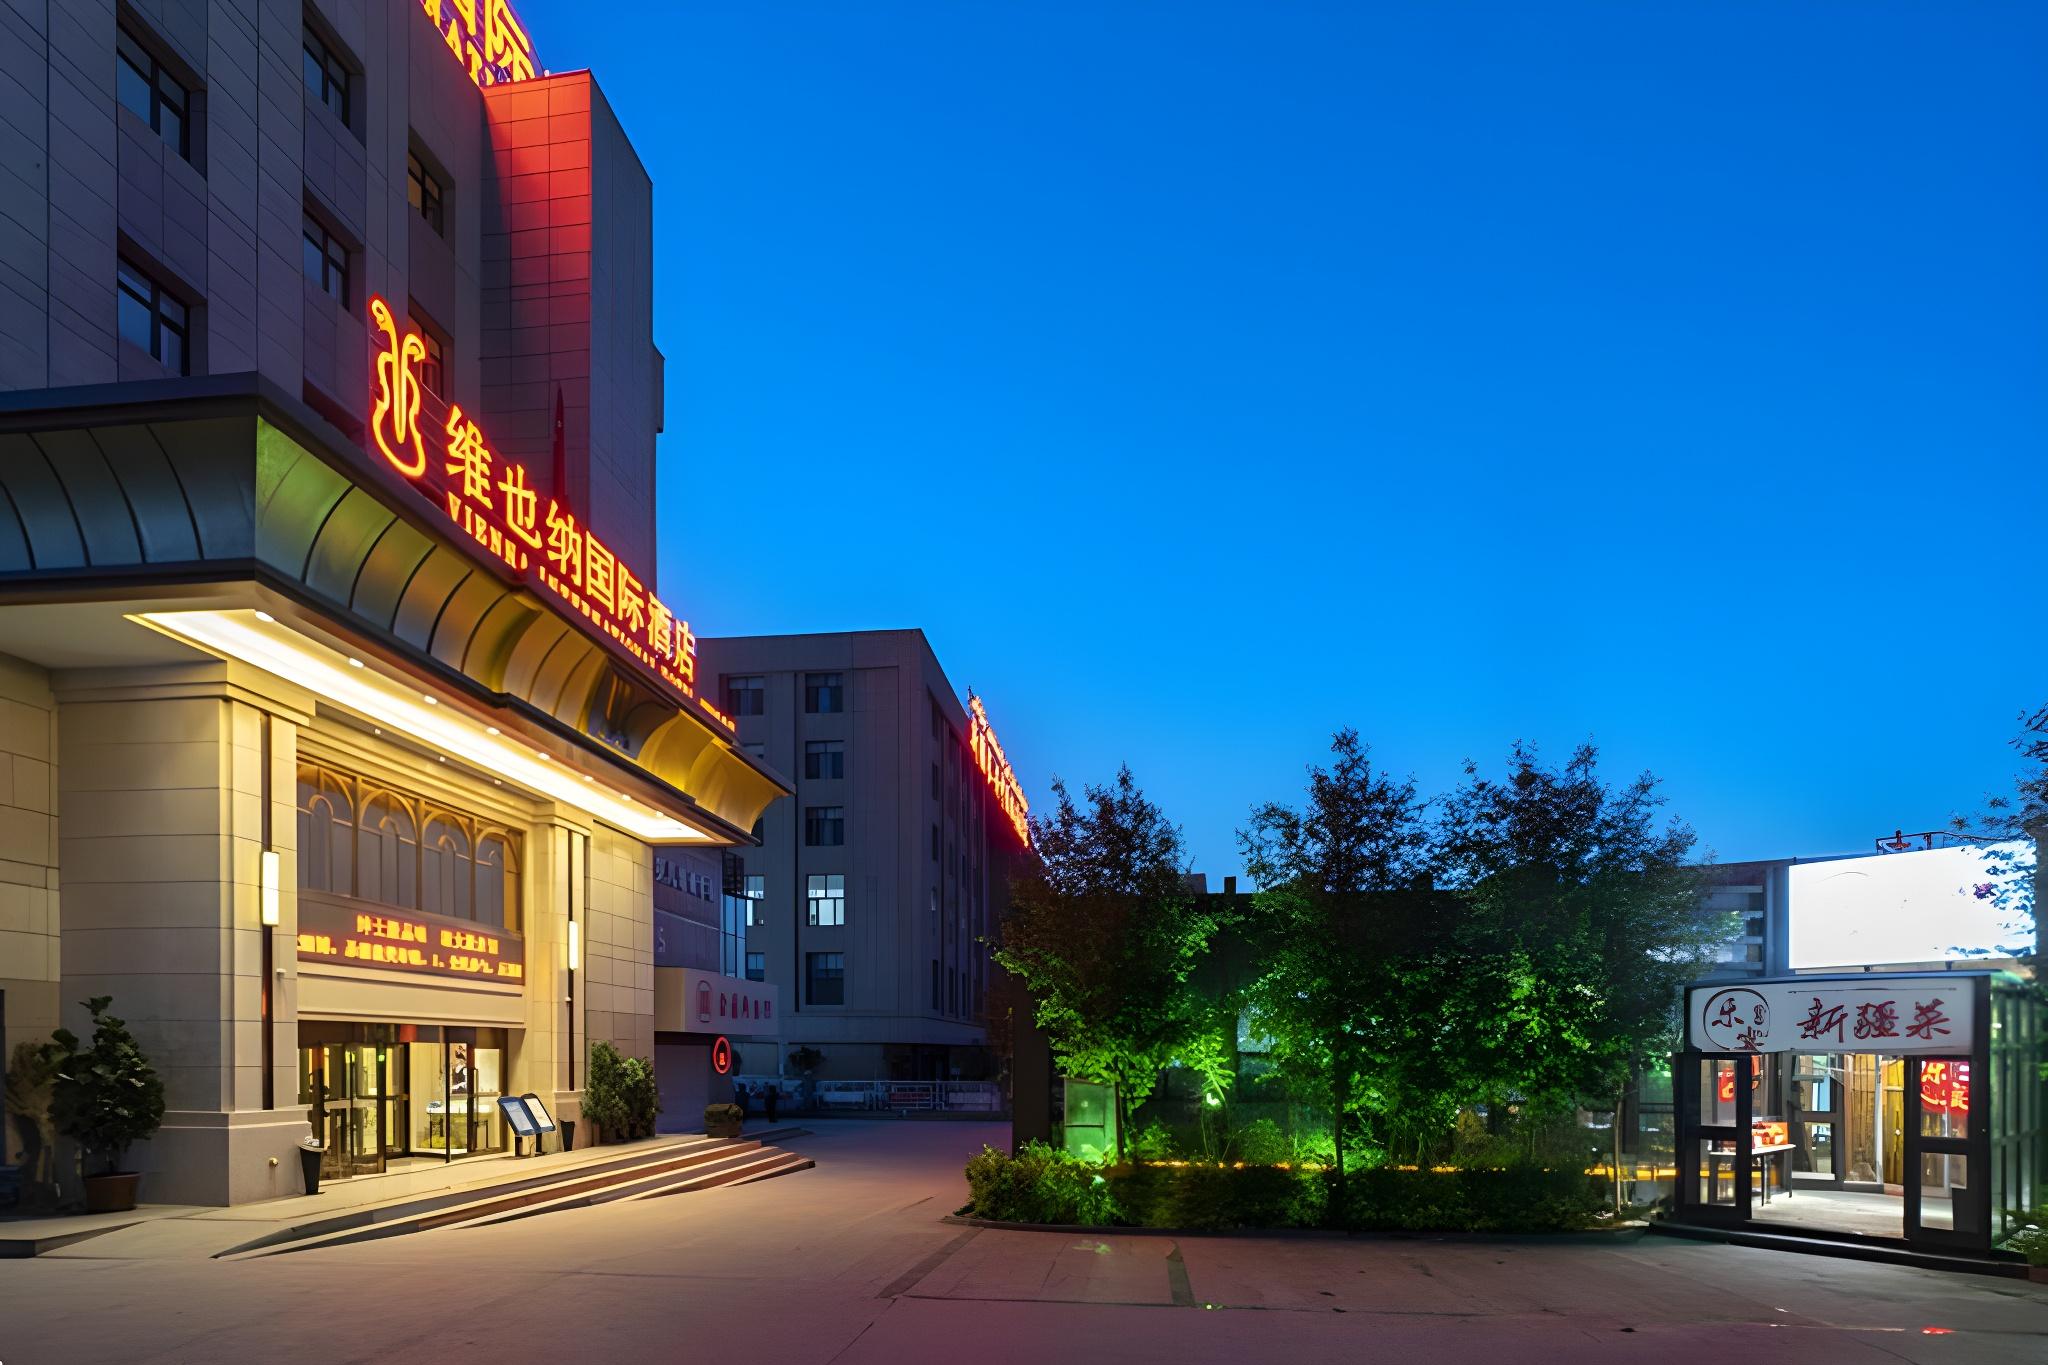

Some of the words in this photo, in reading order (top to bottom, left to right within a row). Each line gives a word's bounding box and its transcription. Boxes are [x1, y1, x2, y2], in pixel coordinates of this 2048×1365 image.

[445, 404, 697, 683] 维也纳国际酒店
